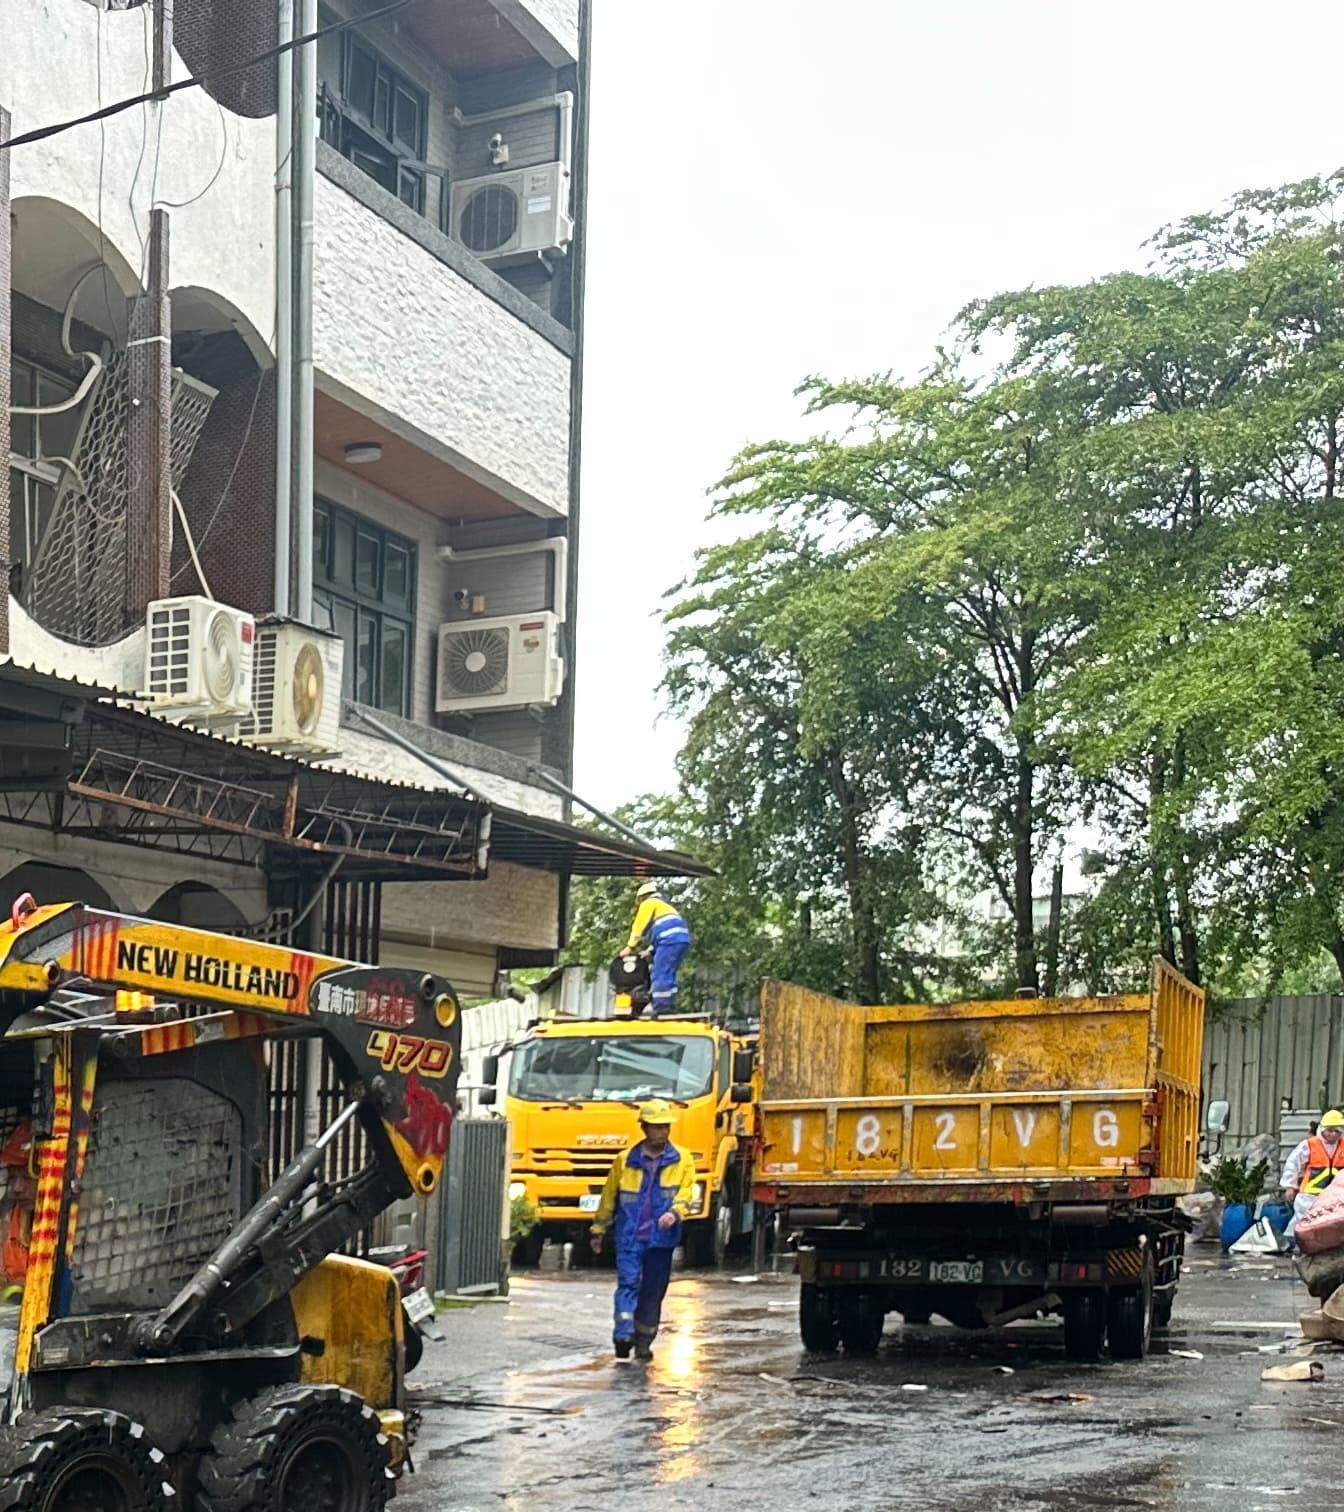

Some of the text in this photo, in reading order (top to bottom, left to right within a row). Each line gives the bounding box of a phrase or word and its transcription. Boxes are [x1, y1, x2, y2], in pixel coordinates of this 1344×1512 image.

[117, 940, 299, 1000] NEW HOLLAND
[367, 1030, 452, 1078] L170
[576, 1134, 629, 1146] ISUZU
[879, 1259, 921, 1277] 182
